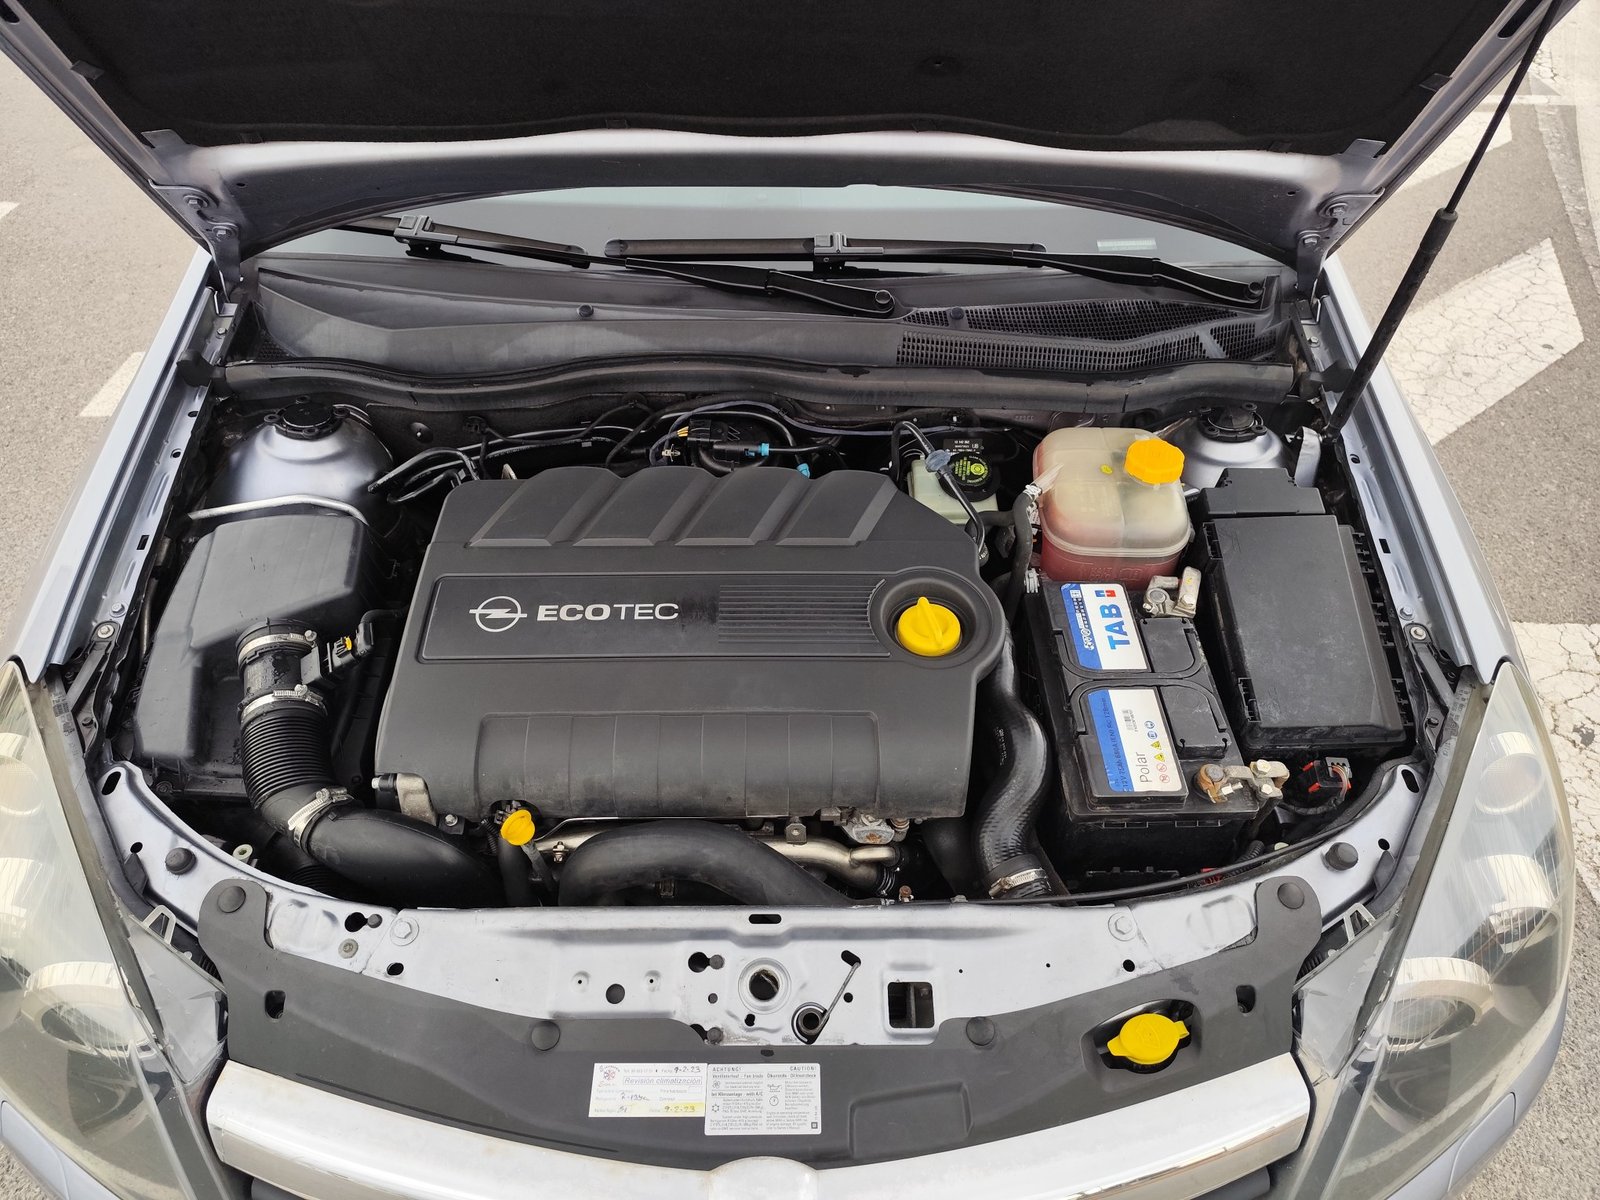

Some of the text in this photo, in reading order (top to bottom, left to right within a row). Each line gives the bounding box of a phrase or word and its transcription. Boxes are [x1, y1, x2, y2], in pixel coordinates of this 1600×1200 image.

[536, 603, 679, 622] ECOTEC
[1101, 603, 1131, 650] TAB
[1135, 751, 1153, 783] Polar
[624, 1077, 654, 1085] Revisión
[655, 1077, 701, 1085] climatización
